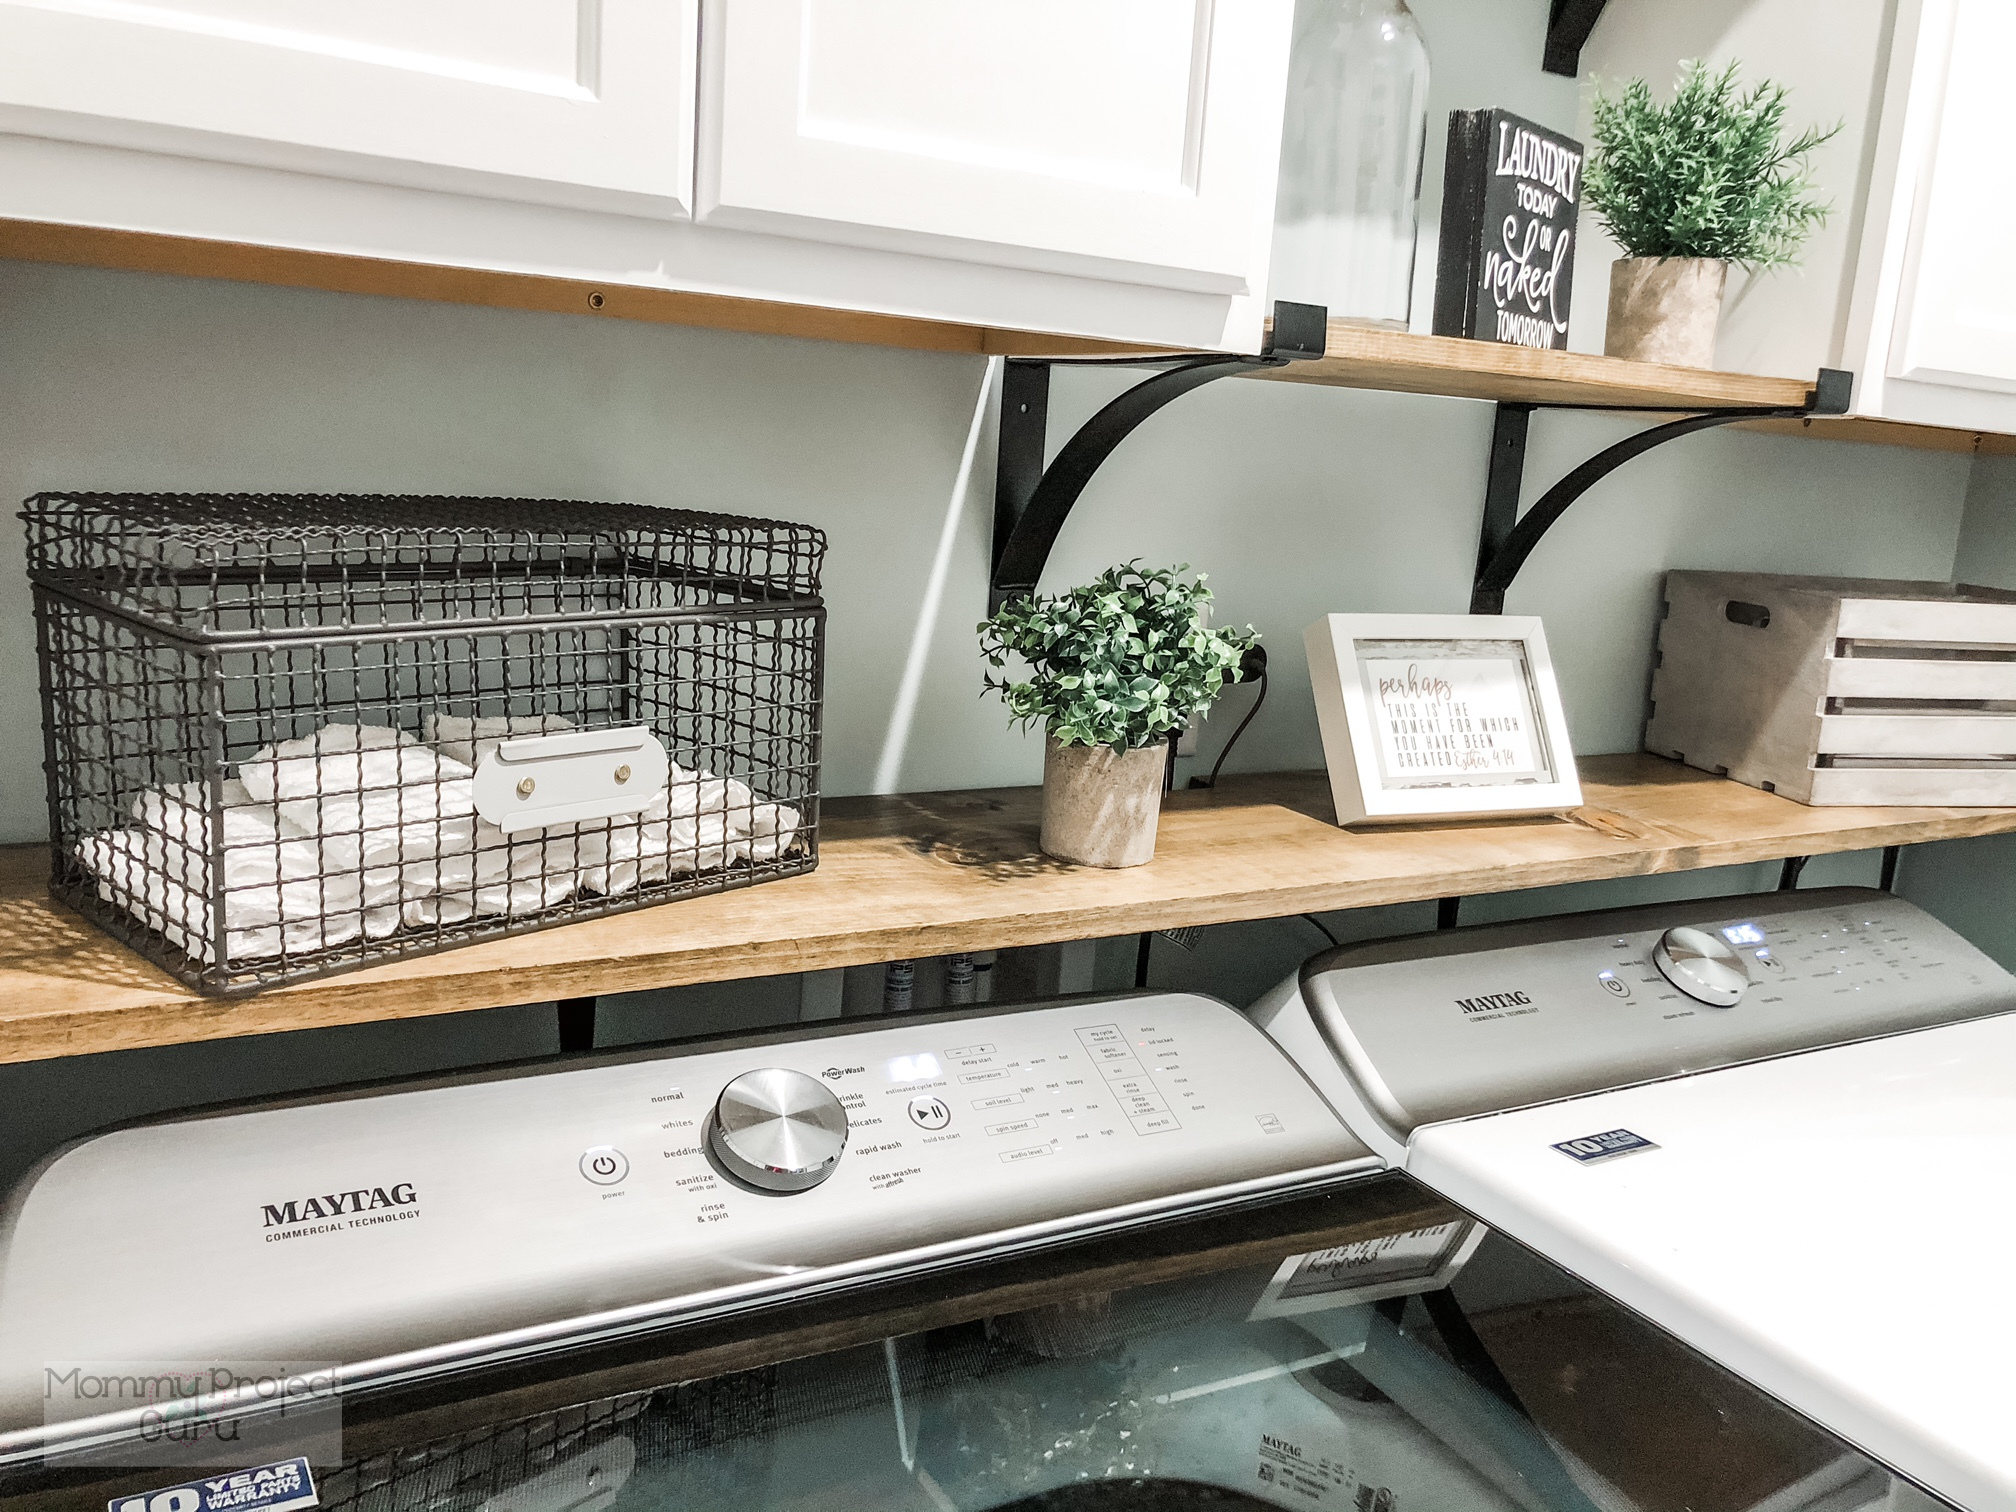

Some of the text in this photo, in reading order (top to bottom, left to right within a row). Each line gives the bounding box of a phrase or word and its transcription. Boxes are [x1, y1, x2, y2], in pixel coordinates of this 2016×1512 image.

[1496, 121, 1581, 203] LAUNDRY
[1516, 183, 1556, 219] TODAY
[1539, 224, 1551, 252] OR
[1484, 214, 1570, 333] naked
[1496, 309, 1554, 349] TOMORROW
[1378, 663, 1454, 707] perhaps
[1387, 702, 1469, 718] THIS IS THE
[1391, 717, 1520, 734] MOMENT FOR WHICH
[1394, 733, 1494, 751] YOU HAVE BEEN
[1397, 752, 1452, 768] CREATED
[1453, 750, 1490, 771] Esther
[1454, 991, 1532, 1014] MAYTAG
[1469, 1007, 1540, 1023] COMMERCIAL TECHNOLOGY
[961, 1059, 977, 1067] delay
[1030, 1057, 1046, 1065] warm
[821, 1066, 865, 1080] PowerWash
[965, 1072, 1001, 1082] temperature
[885, 1085, 916, 1095] estimated
[1020, 1086, 1035, 1094] light
[1066, 1079, 1083, 1087] heavy
[651, 1092, 685, 1103] normal
[839, 1092, 864, 1102] rinkle
[844, 1100, 867, 1110] ntrol
[661, 1119, 694, 1130] whites
[849, 1117, 883, 1129] elicates
[1010, 1122, 1029, 1130] speed
[945, 1132, 961, 1140] start
[1100, 1128, 1114, 1136] high
[663, 1146, 705, 1159] bedding
[855, 1140, 902, 1156] rapid wash
[1010, 1148, 1043, 1159] audio level
[1559, 1140, 1604, 1156] 10
[675, 1173, 715, 1187] sanitize
[869, 1167, 922, 1182] clean washer
[602, 1190, 626, 1200] power
[687, 1184, 705, 1193] with
[260, 1183, 417, 1228] MAYTAG
[700, 1202, 726, 1213] rinse
[697, 1211, 729, 1223] & spin
[265, 1209, 422, 1243] COMMERCIAL TECHNOLOGY
[205, 1464, 299, 1493] YEAR
[207, 1480, 301, 1510] WARRANTY
